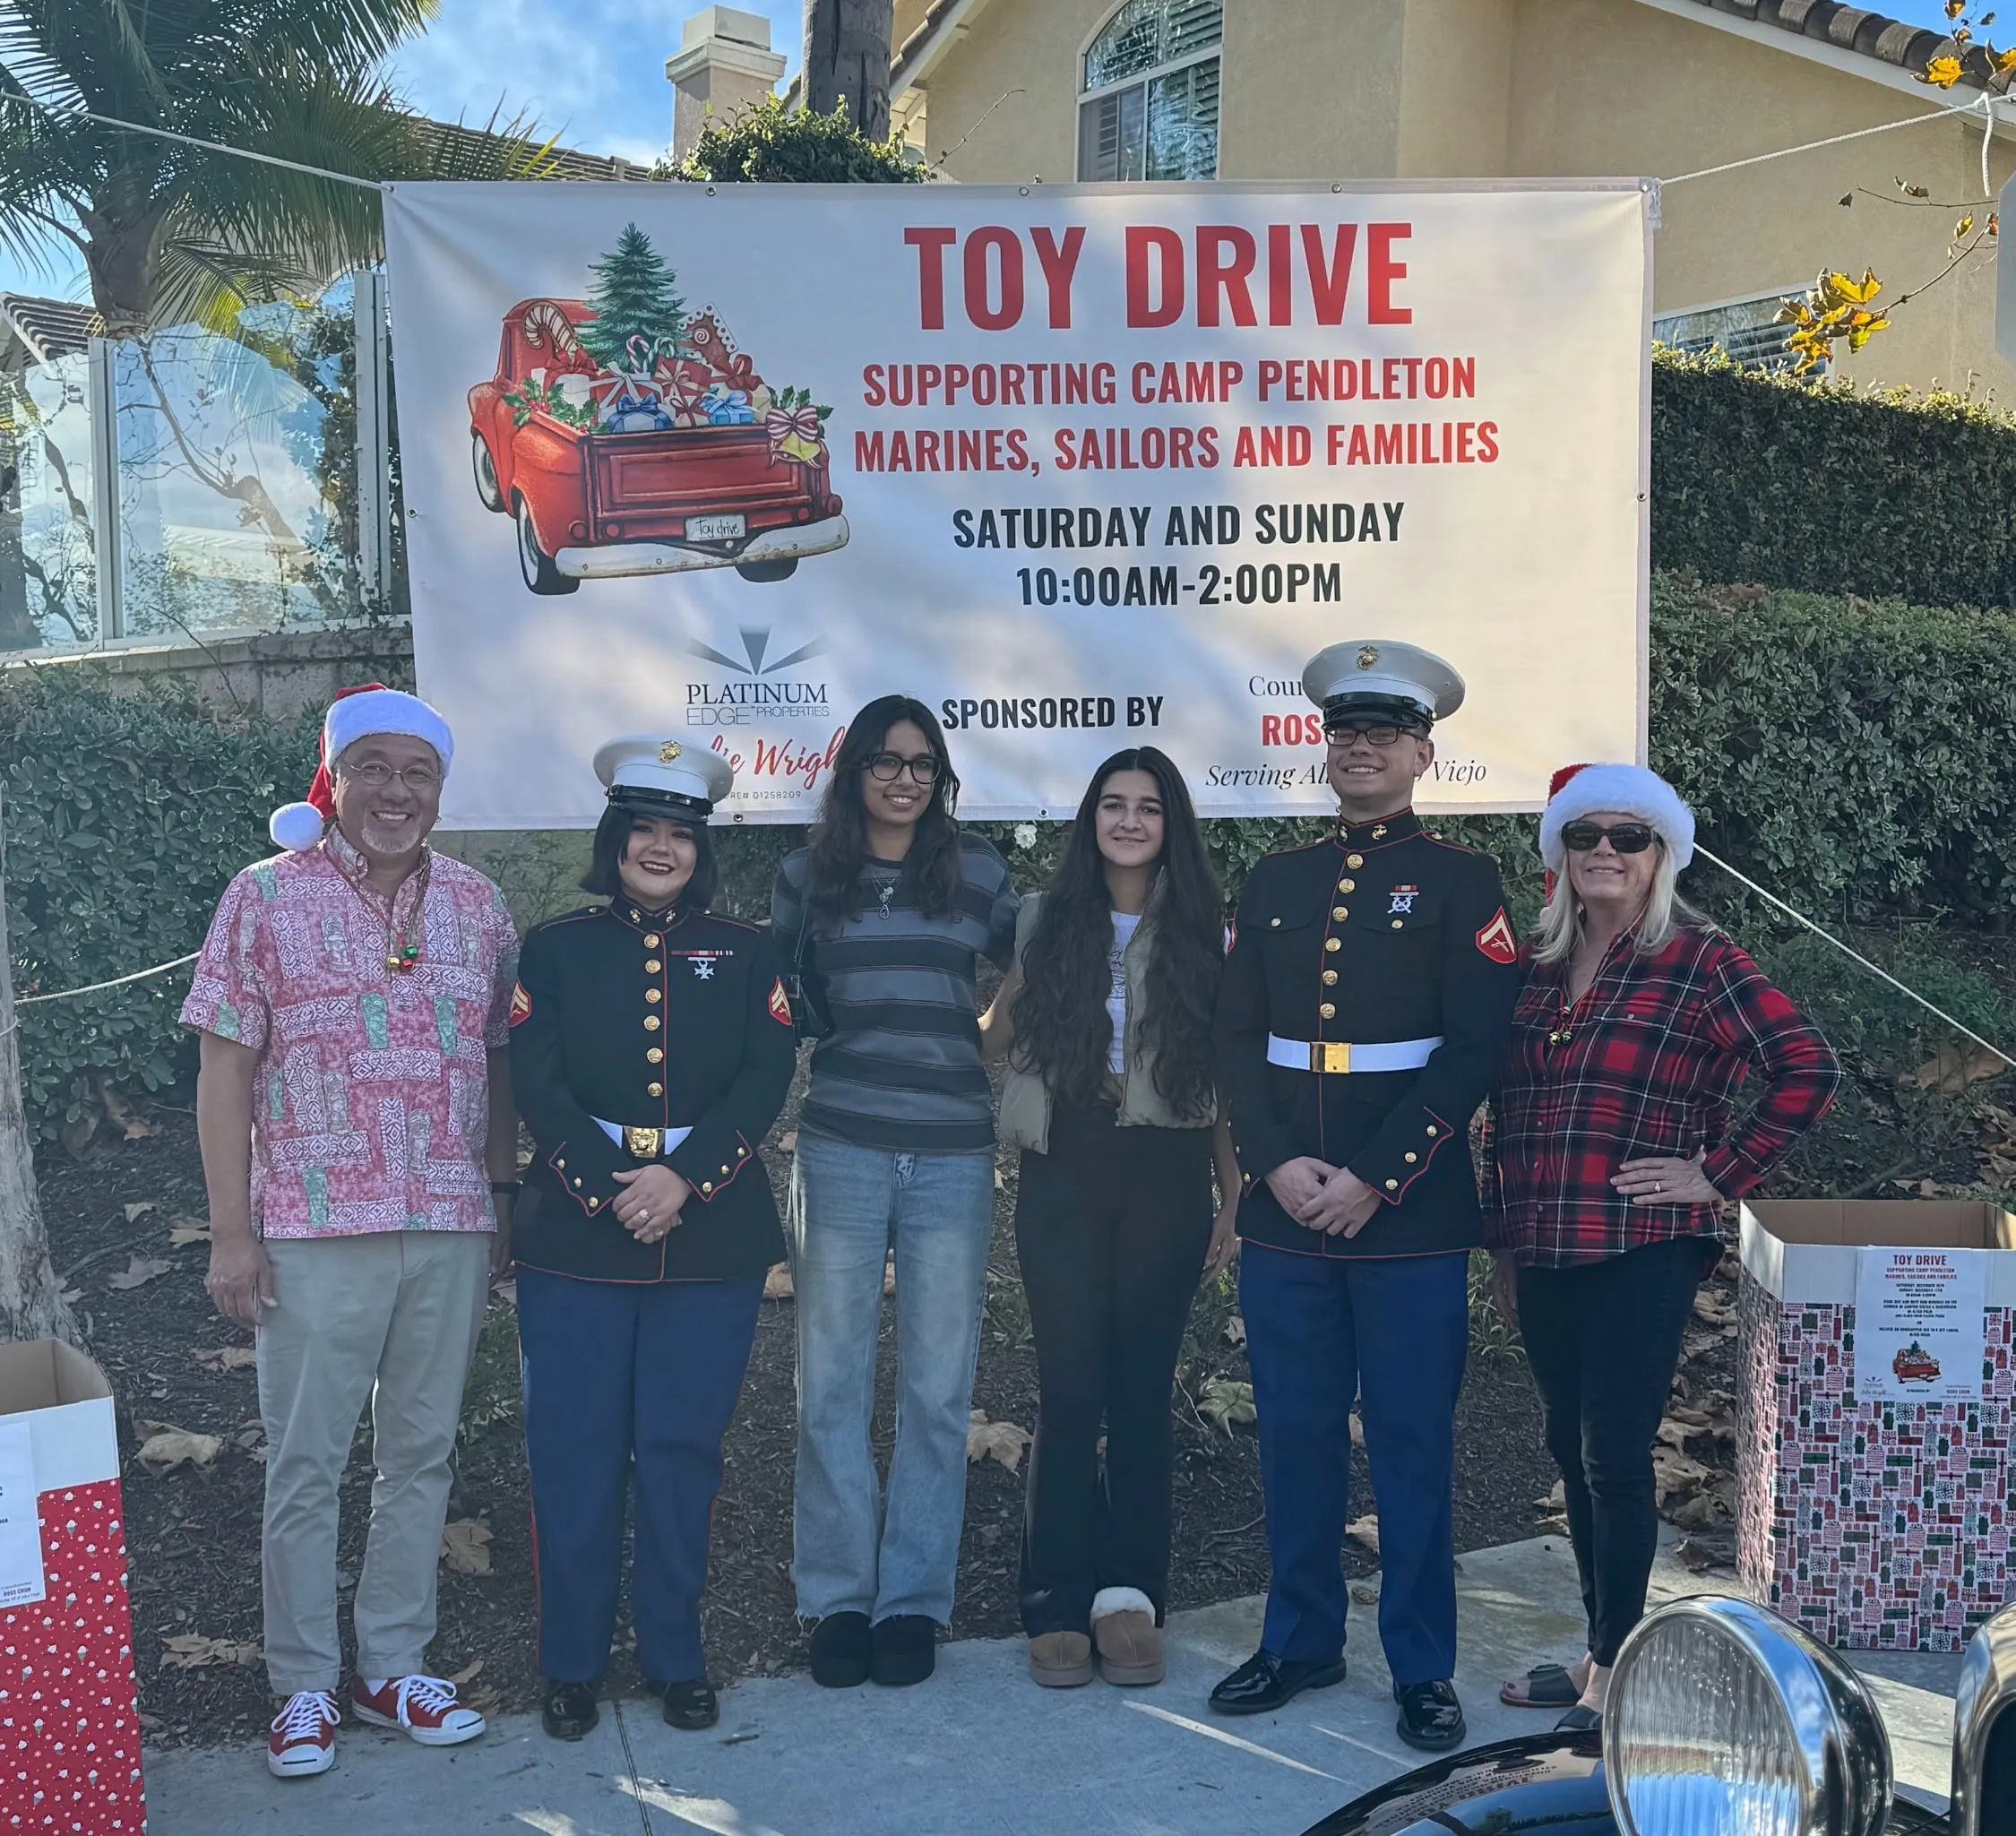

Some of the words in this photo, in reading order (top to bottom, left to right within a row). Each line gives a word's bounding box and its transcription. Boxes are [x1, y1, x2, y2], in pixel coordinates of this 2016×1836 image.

[904, 227, 1086, 330] TOY
[1125, 222, 1413, 328] DRIVE
[863, 360, 1116, 407] SUPPORTING
[1132, 360, 1243, 403] CAMP
[1258, 357, 1477, 402] PENDLETON
[855, 428, 1040, 477] MARINES,
[1055, 427, 1219, 470] SAILORS
[1233, 425, 1312, 468] AND
[1326, 420, 1500, 467] FAMILIES
[695, 518, 714, 539] Toy
[717, 519, 740, 538] drive
[952, 506, 1151, 549] SATURDAY
[1164, 505, 1240, 547] AND
[1255, 502, 1405, 545] SUNDAY
[1016, 563, 1342, 608] 10:00AM-2:00PM
[685, 683, 829, 704] PLATINUM
[756, 705, 830, 718] PROPERTIES
[941, 697, 1115, 729] SPONSORED
[1126, 695, 1164, 727] BY
[1262, 713, 1322, 746] ROS
[1205, 763, 1297, 790] Serving
[1434, 759, 1487, 787] Viejo
[753, 790, 802, 800] 01258209
[1892, 1254, 1912, 1265] TOY
[1916, 1254, 1947, 1265] DRIVE
